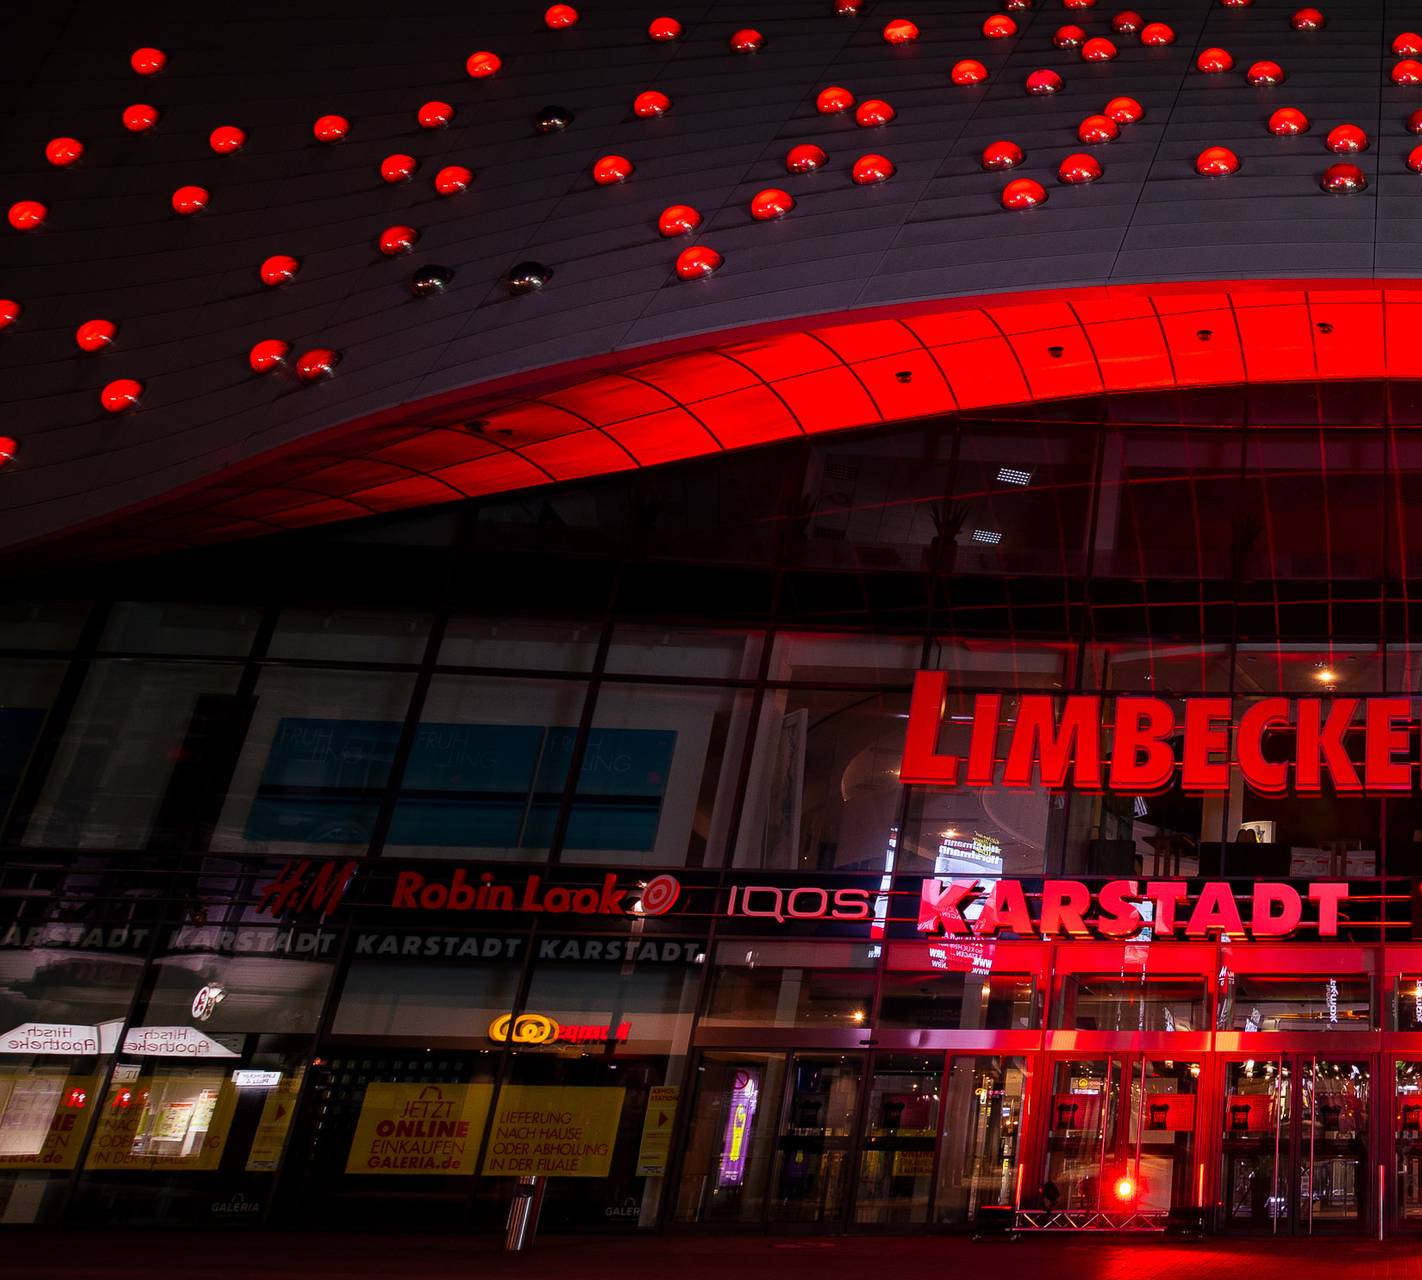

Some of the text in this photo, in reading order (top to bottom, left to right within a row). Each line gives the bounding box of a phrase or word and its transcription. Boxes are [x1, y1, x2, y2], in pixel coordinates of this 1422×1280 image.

[391, 867, 629, 915] Robin Look
[726, 885, 871, 923] IQOS
[917, 879, 1350, 940] KARSTADT
[168, 925, 338, 953] KARSTADT
[355, 933, 523, 959] KARSTADT
[538, 939, 700, 962] KARSTADT
[400, 1101, 455, 1119] JETZT
[499, 1112, 572, 1125] LIEFERUNG
[376, 1120, 471, 1139] ONLINE
[496, 1127, 583, 1141] NACH HAUSE
[370, 1139, 466, 1155] EINKAUFEN
[492, 1142, 609, 1157] ODER ABHOLUNG
[367, 1155, 461, 1170] GALERIA.de
[489, 1158, 579, 1172] IN DER FILIALE
[210, 1201, 261, 1213] GALERIA
